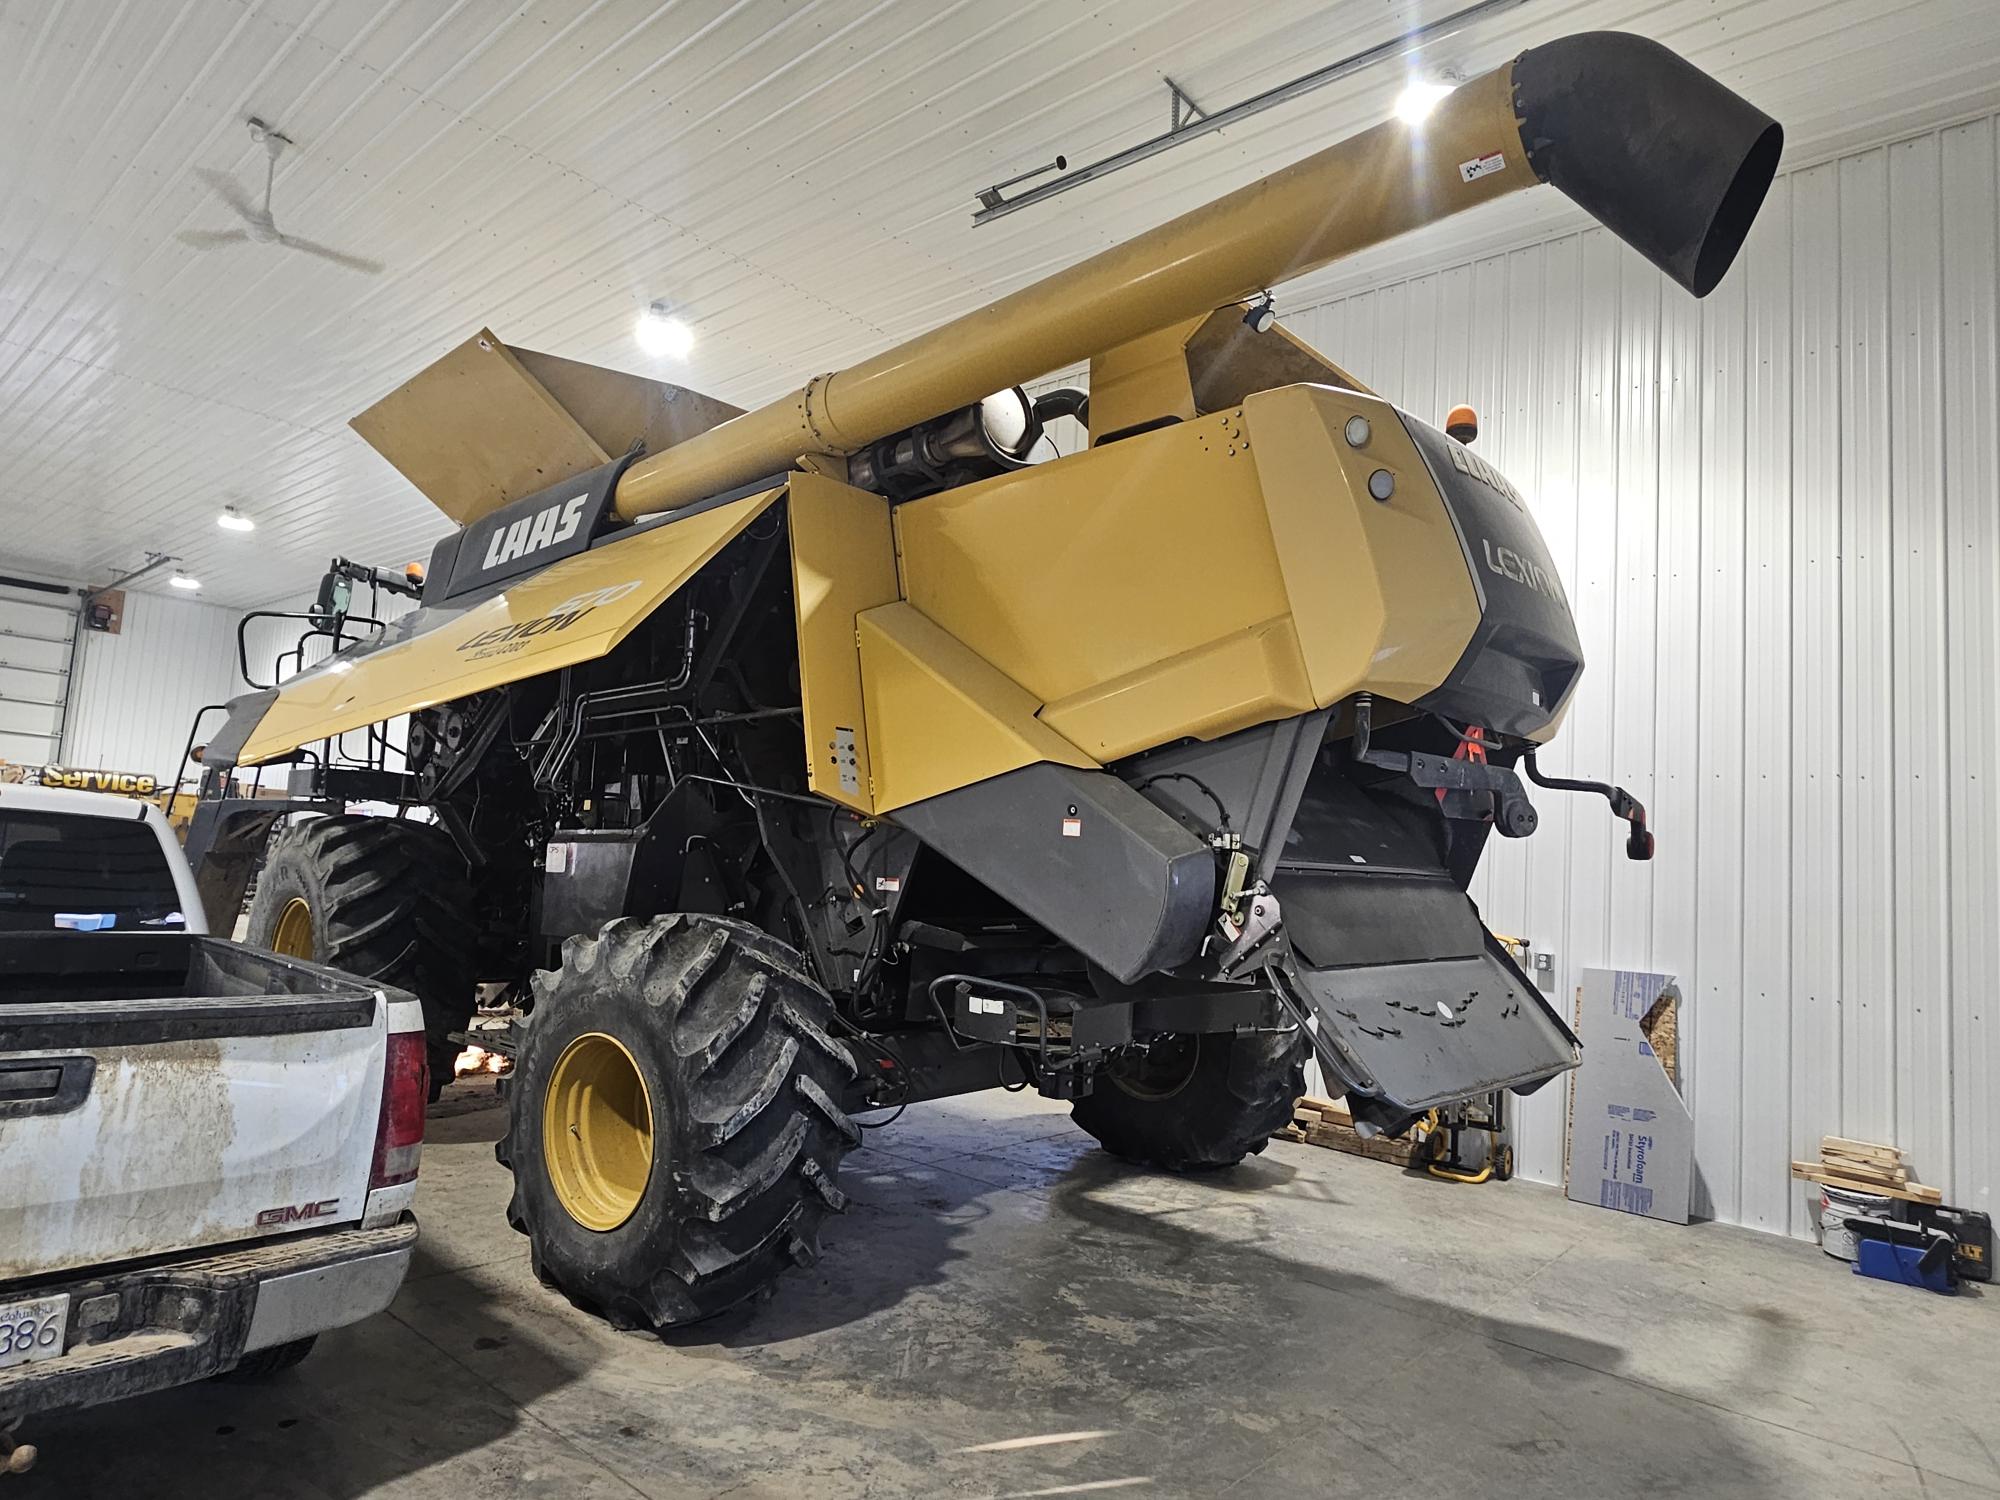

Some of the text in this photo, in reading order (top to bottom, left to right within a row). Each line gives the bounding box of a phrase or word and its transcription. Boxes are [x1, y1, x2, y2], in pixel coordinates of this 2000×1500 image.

[456, 606, 597, 651] LEXION
[43, 763, 155, 793] Service
[1635, 1135, 1648, 1184] Styrofoam
[256, 1198, 340, 1226] GMC
